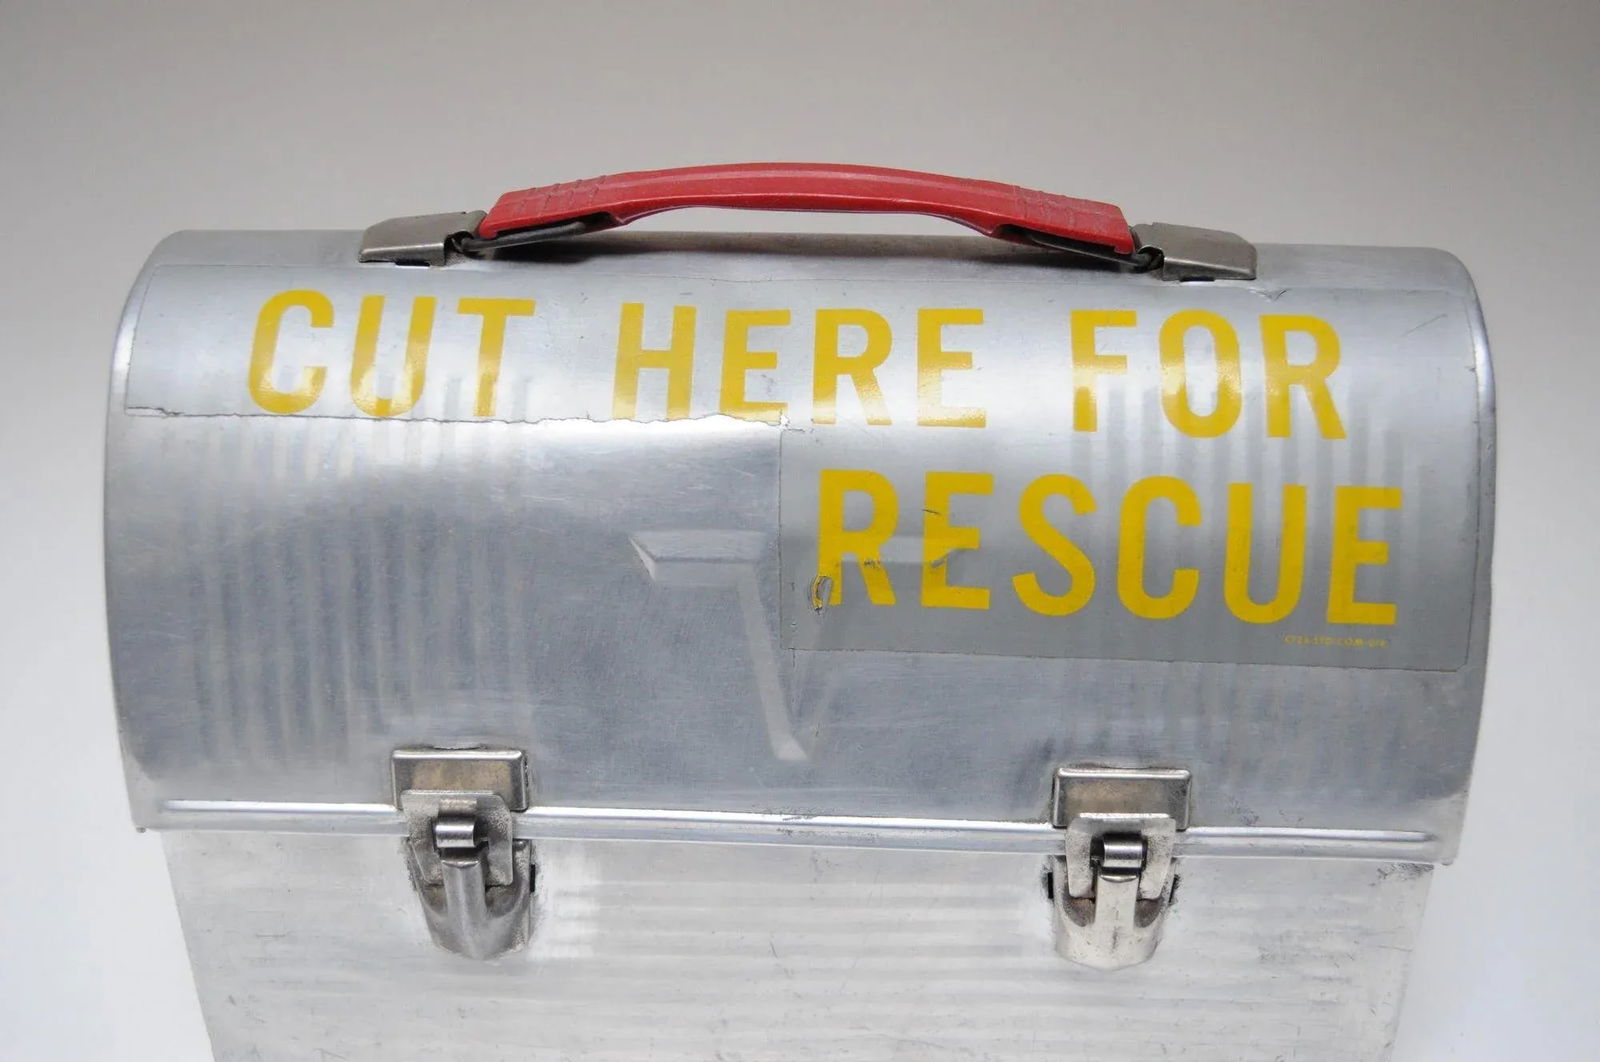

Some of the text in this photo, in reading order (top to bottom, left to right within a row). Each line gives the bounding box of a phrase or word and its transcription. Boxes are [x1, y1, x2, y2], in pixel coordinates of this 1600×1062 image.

[248, 289, 1347, 440] CUT HERE FOR
[811, 469, 1403, 626] RESCUE
